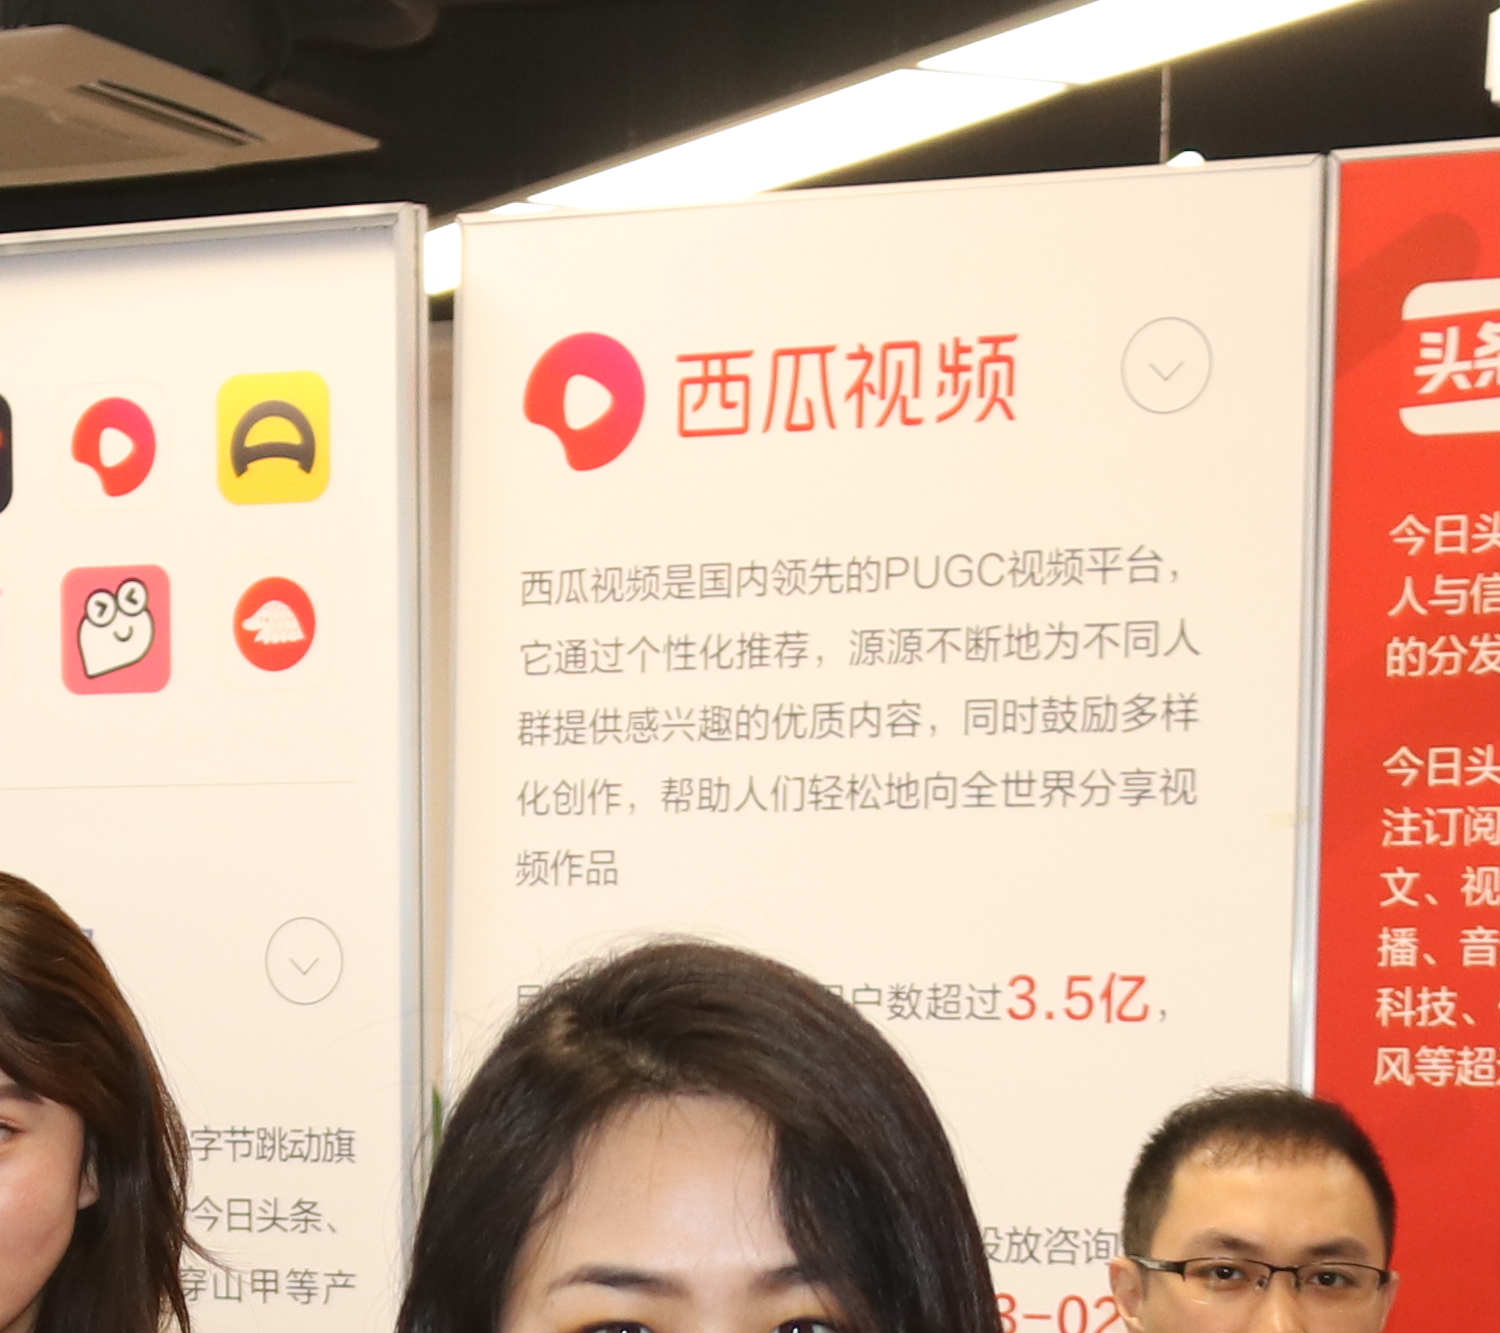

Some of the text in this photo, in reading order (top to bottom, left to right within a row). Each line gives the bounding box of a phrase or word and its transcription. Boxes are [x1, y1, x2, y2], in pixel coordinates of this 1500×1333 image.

[676, 333, 1019, 437] 西瓜视频
[520, 544, 1181, 606] 西瓜视频是国内领先的PUGC视频平台，
[520, 619, 1200, 676] 它通过个性化推荐，源源不断地为不同人
[517, 692, 1199, 747] 群提供感兴趣的优质内容，同时鼓励多样
[516, 767, 1198, 816] 化创作，帮助人们轻松地向全世界分享视
[516, 849, 619, 888] 频作品
[189, 1125, 356, 1163] 字节跳动旗
[180, 1266, 356, 1305] 穿山甲等产
